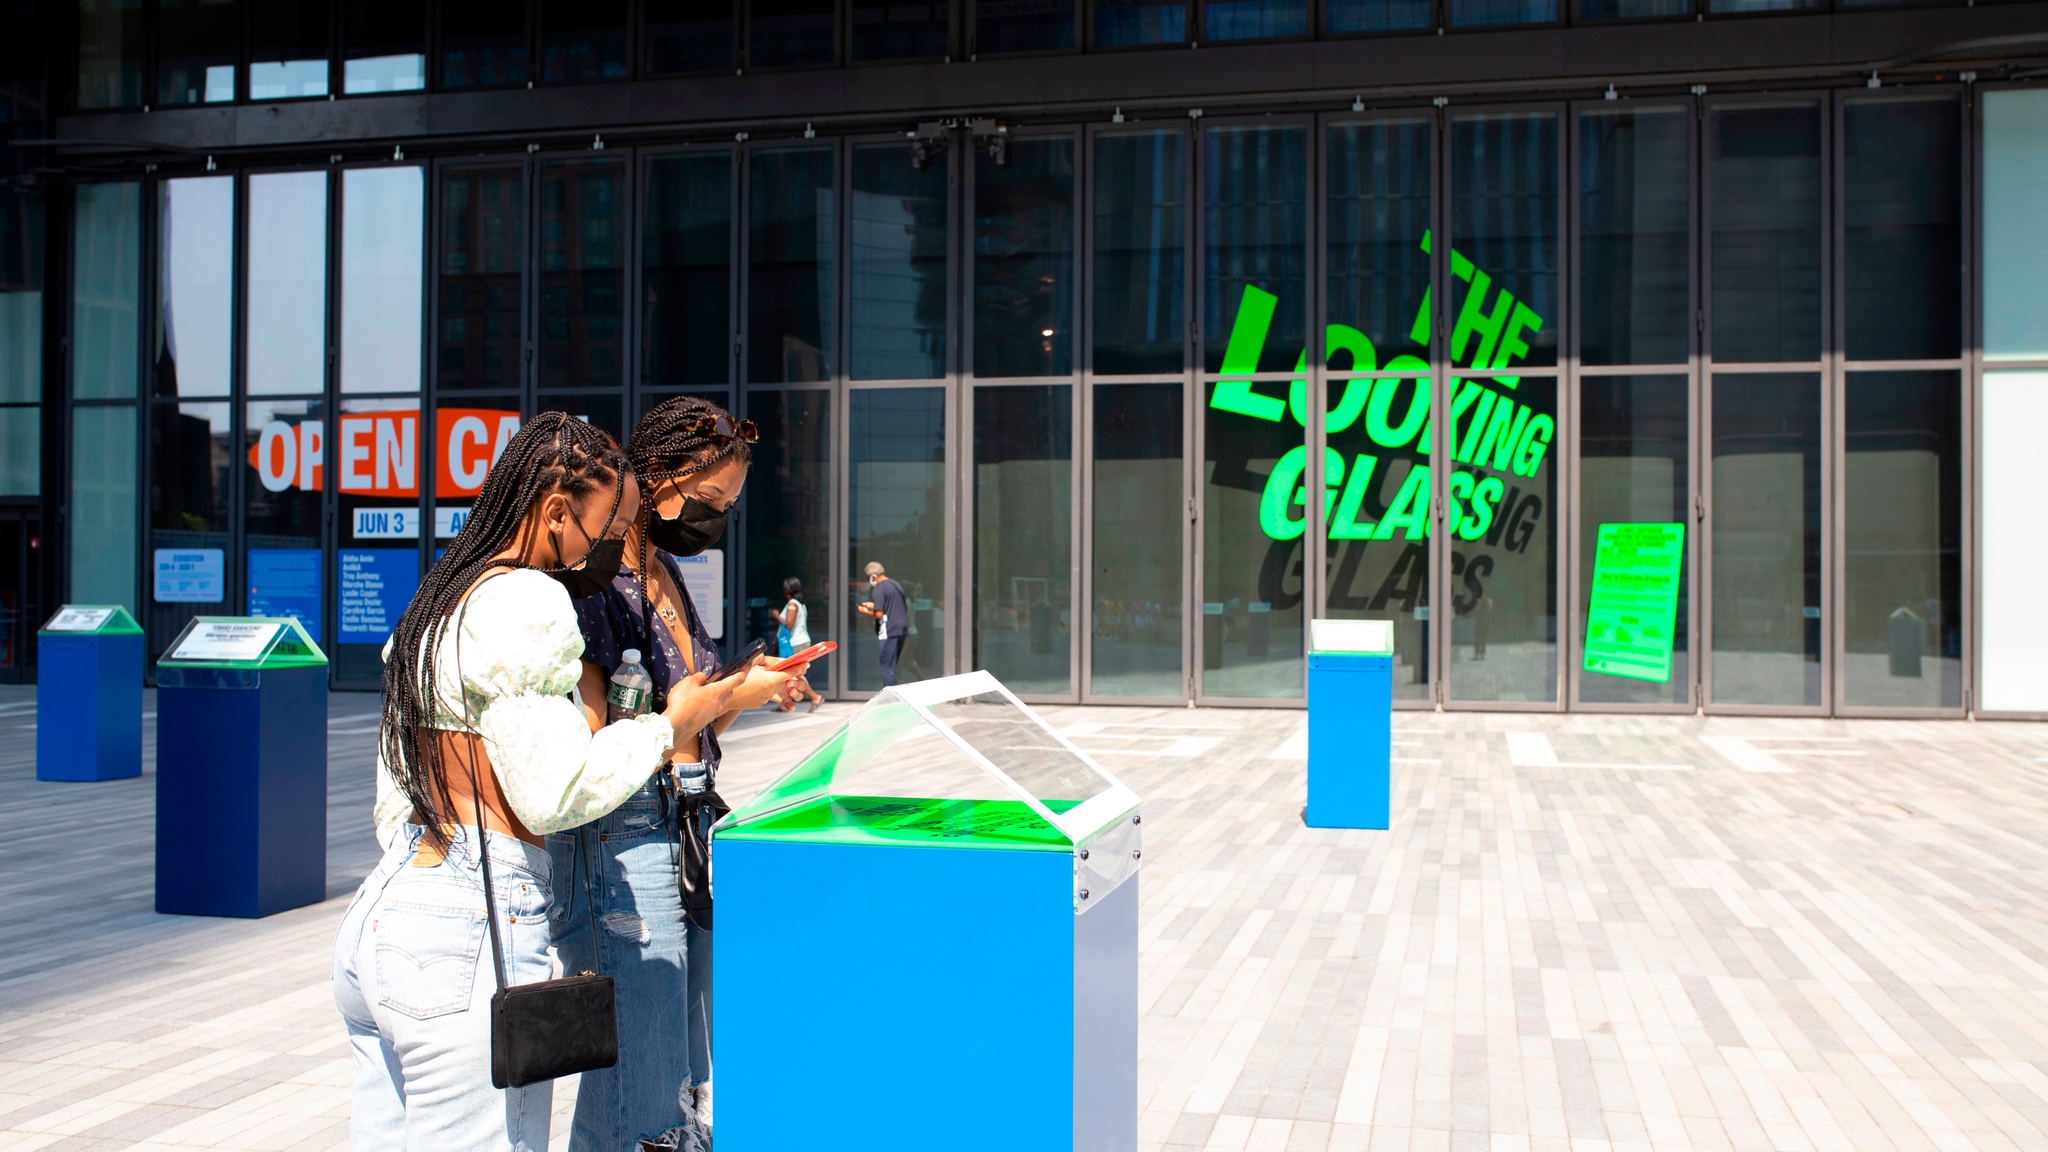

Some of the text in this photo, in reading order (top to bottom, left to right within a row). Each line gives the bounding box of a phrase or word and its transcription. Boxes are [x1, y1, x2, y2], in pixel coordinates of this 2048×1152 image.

[1410, 229, 1543, 390] THE
[1209, 284, 1554, 479] LOOKING
[258, 417, 416, 492] OPEN
[1259, 445, 1505, 541] GLASS
[357, 513, 404, 533] JUN 3
